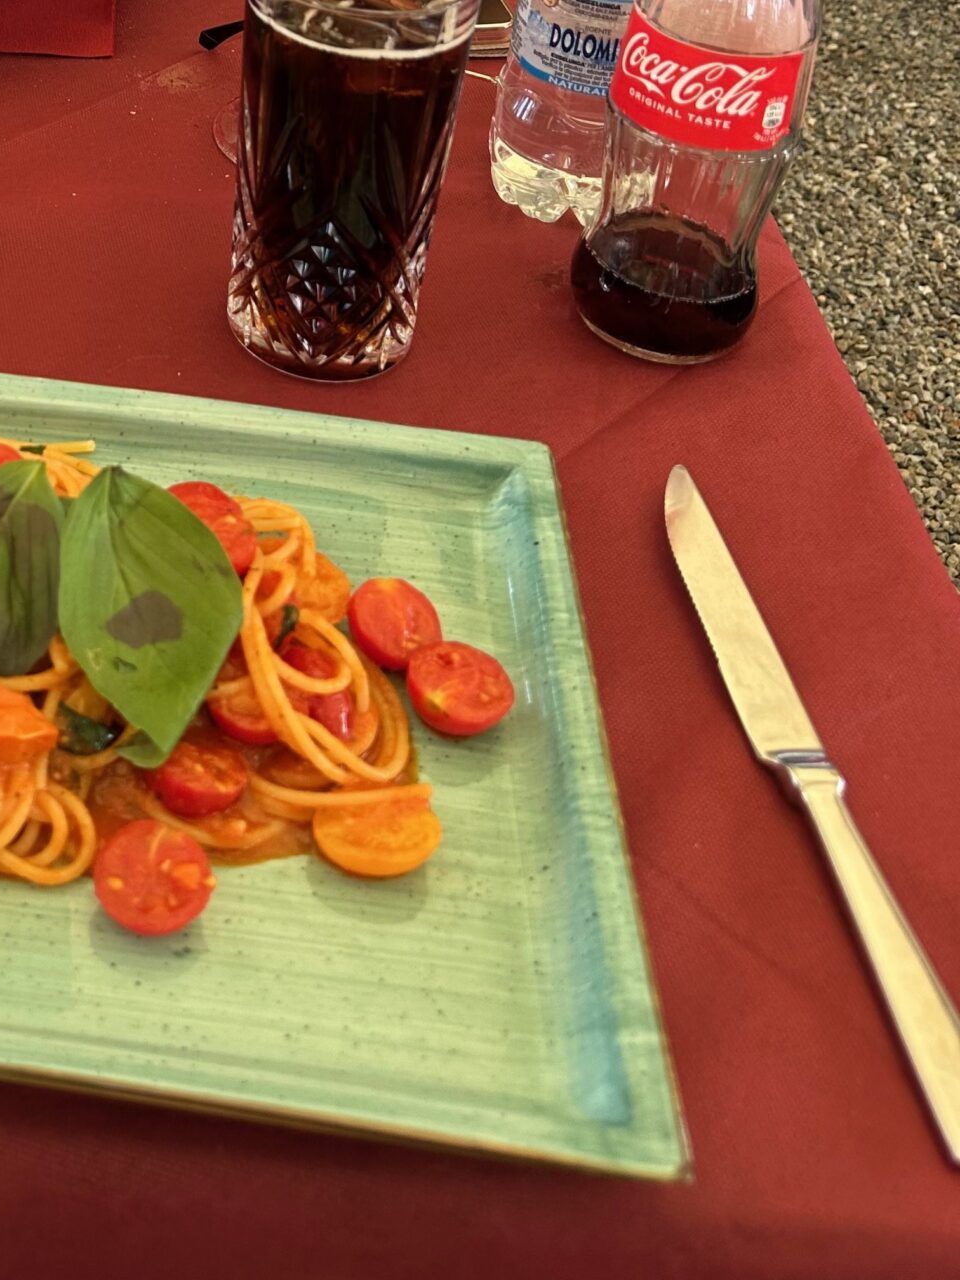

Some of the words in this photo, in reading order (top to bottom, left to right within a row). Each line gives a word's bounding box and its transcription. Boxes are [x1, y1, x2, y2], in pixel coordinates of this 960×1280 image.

[549, 22, 621, 62] DOLOMI
[548, 75, 608, 97] NATURAL
[621, 32, 777, 117] Coca-Cola
[628, 87, 683, 119] ORIGINAL
[687, 113, 732, 130] TASTE
